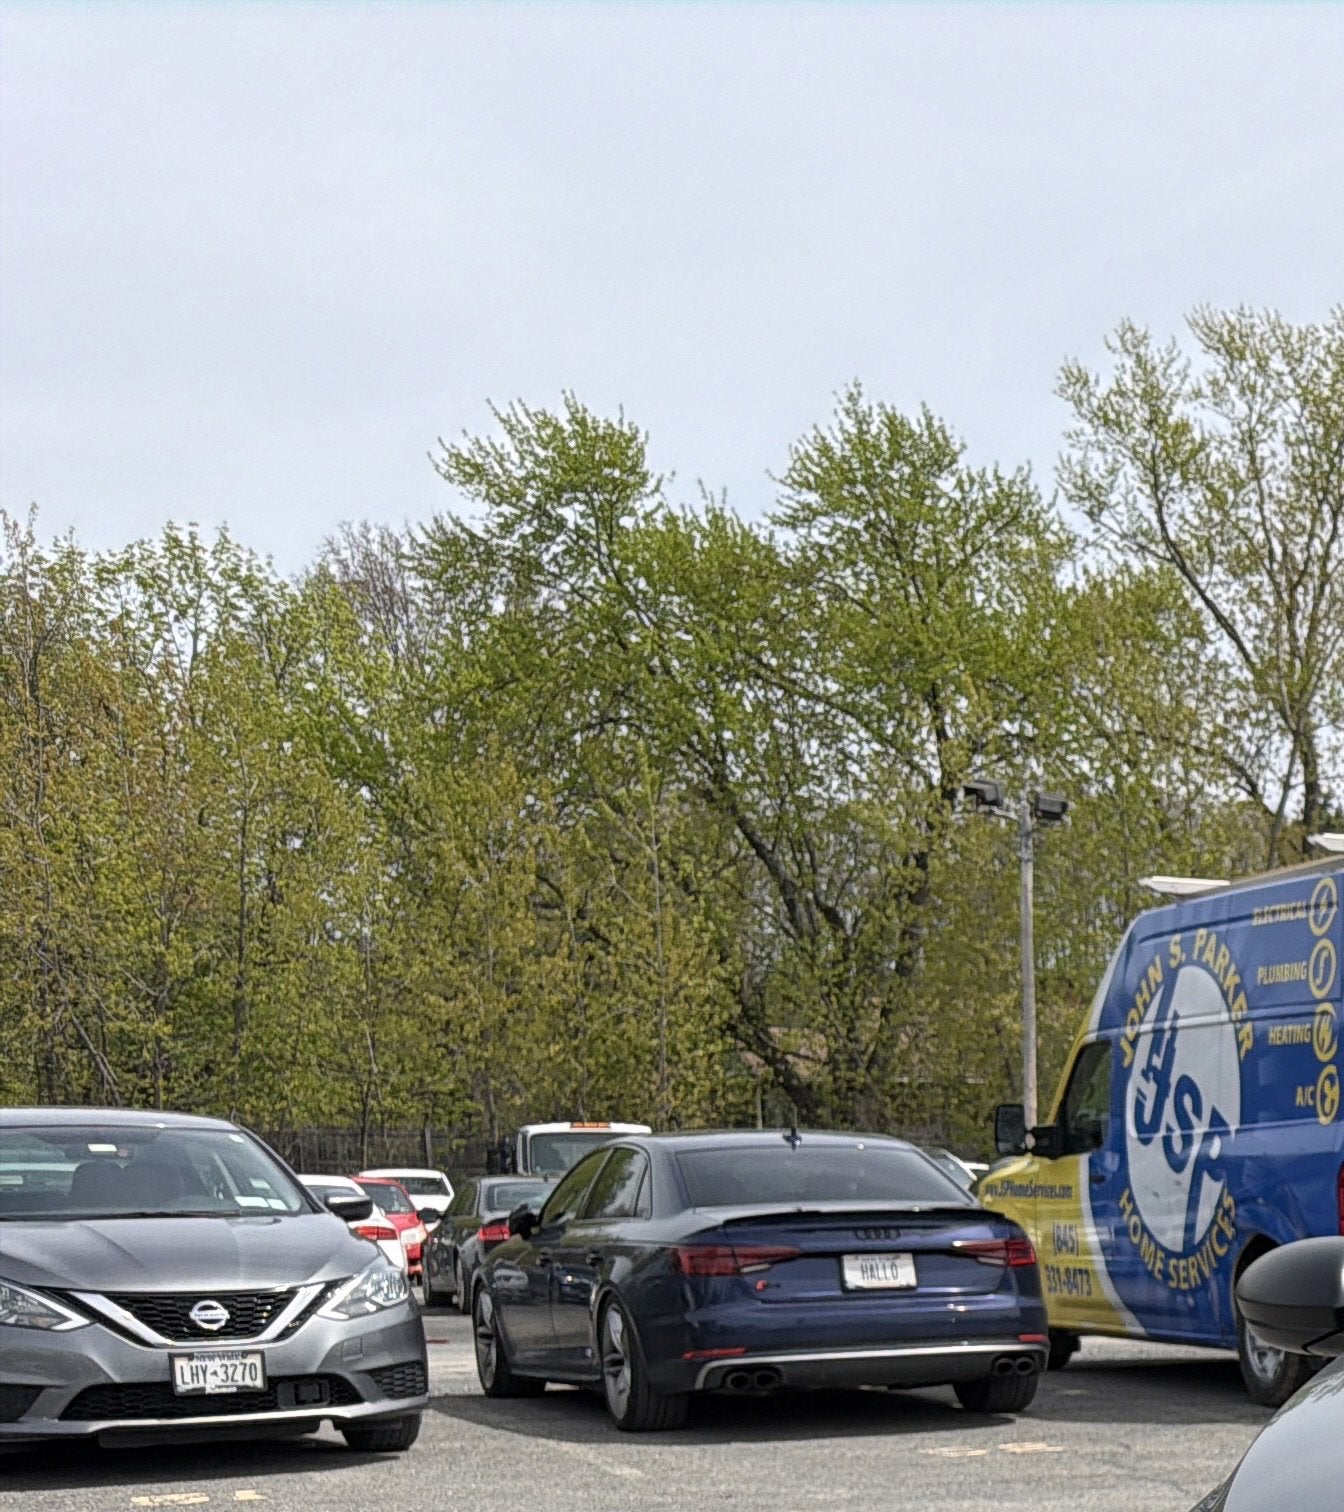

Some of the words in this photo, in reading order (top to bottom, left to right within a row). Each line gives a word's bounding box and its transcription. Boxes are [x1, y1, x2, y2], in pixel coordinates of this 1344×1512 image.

[1252, 901, 1308, 926] ELECTRICAL
[1257, 961, 1308, 985] PLUMBING
[1120, 955, 1163, 1068] JOHN
[1170, 933, 1187, 969] S.
[1193, 928, 1254, 1062] PARKER
[1268, 1023, 1311, 1046] HEATING
[1295, 1085, 1315, 1107] A/C
[1053, 1222, 1080, 1257] (845)
[1119, 1188, 1165, 1281] HOME
[1168, 1187, 1236, 1290] SERVICES
[860, 1262, 899, 1281] HALLO
